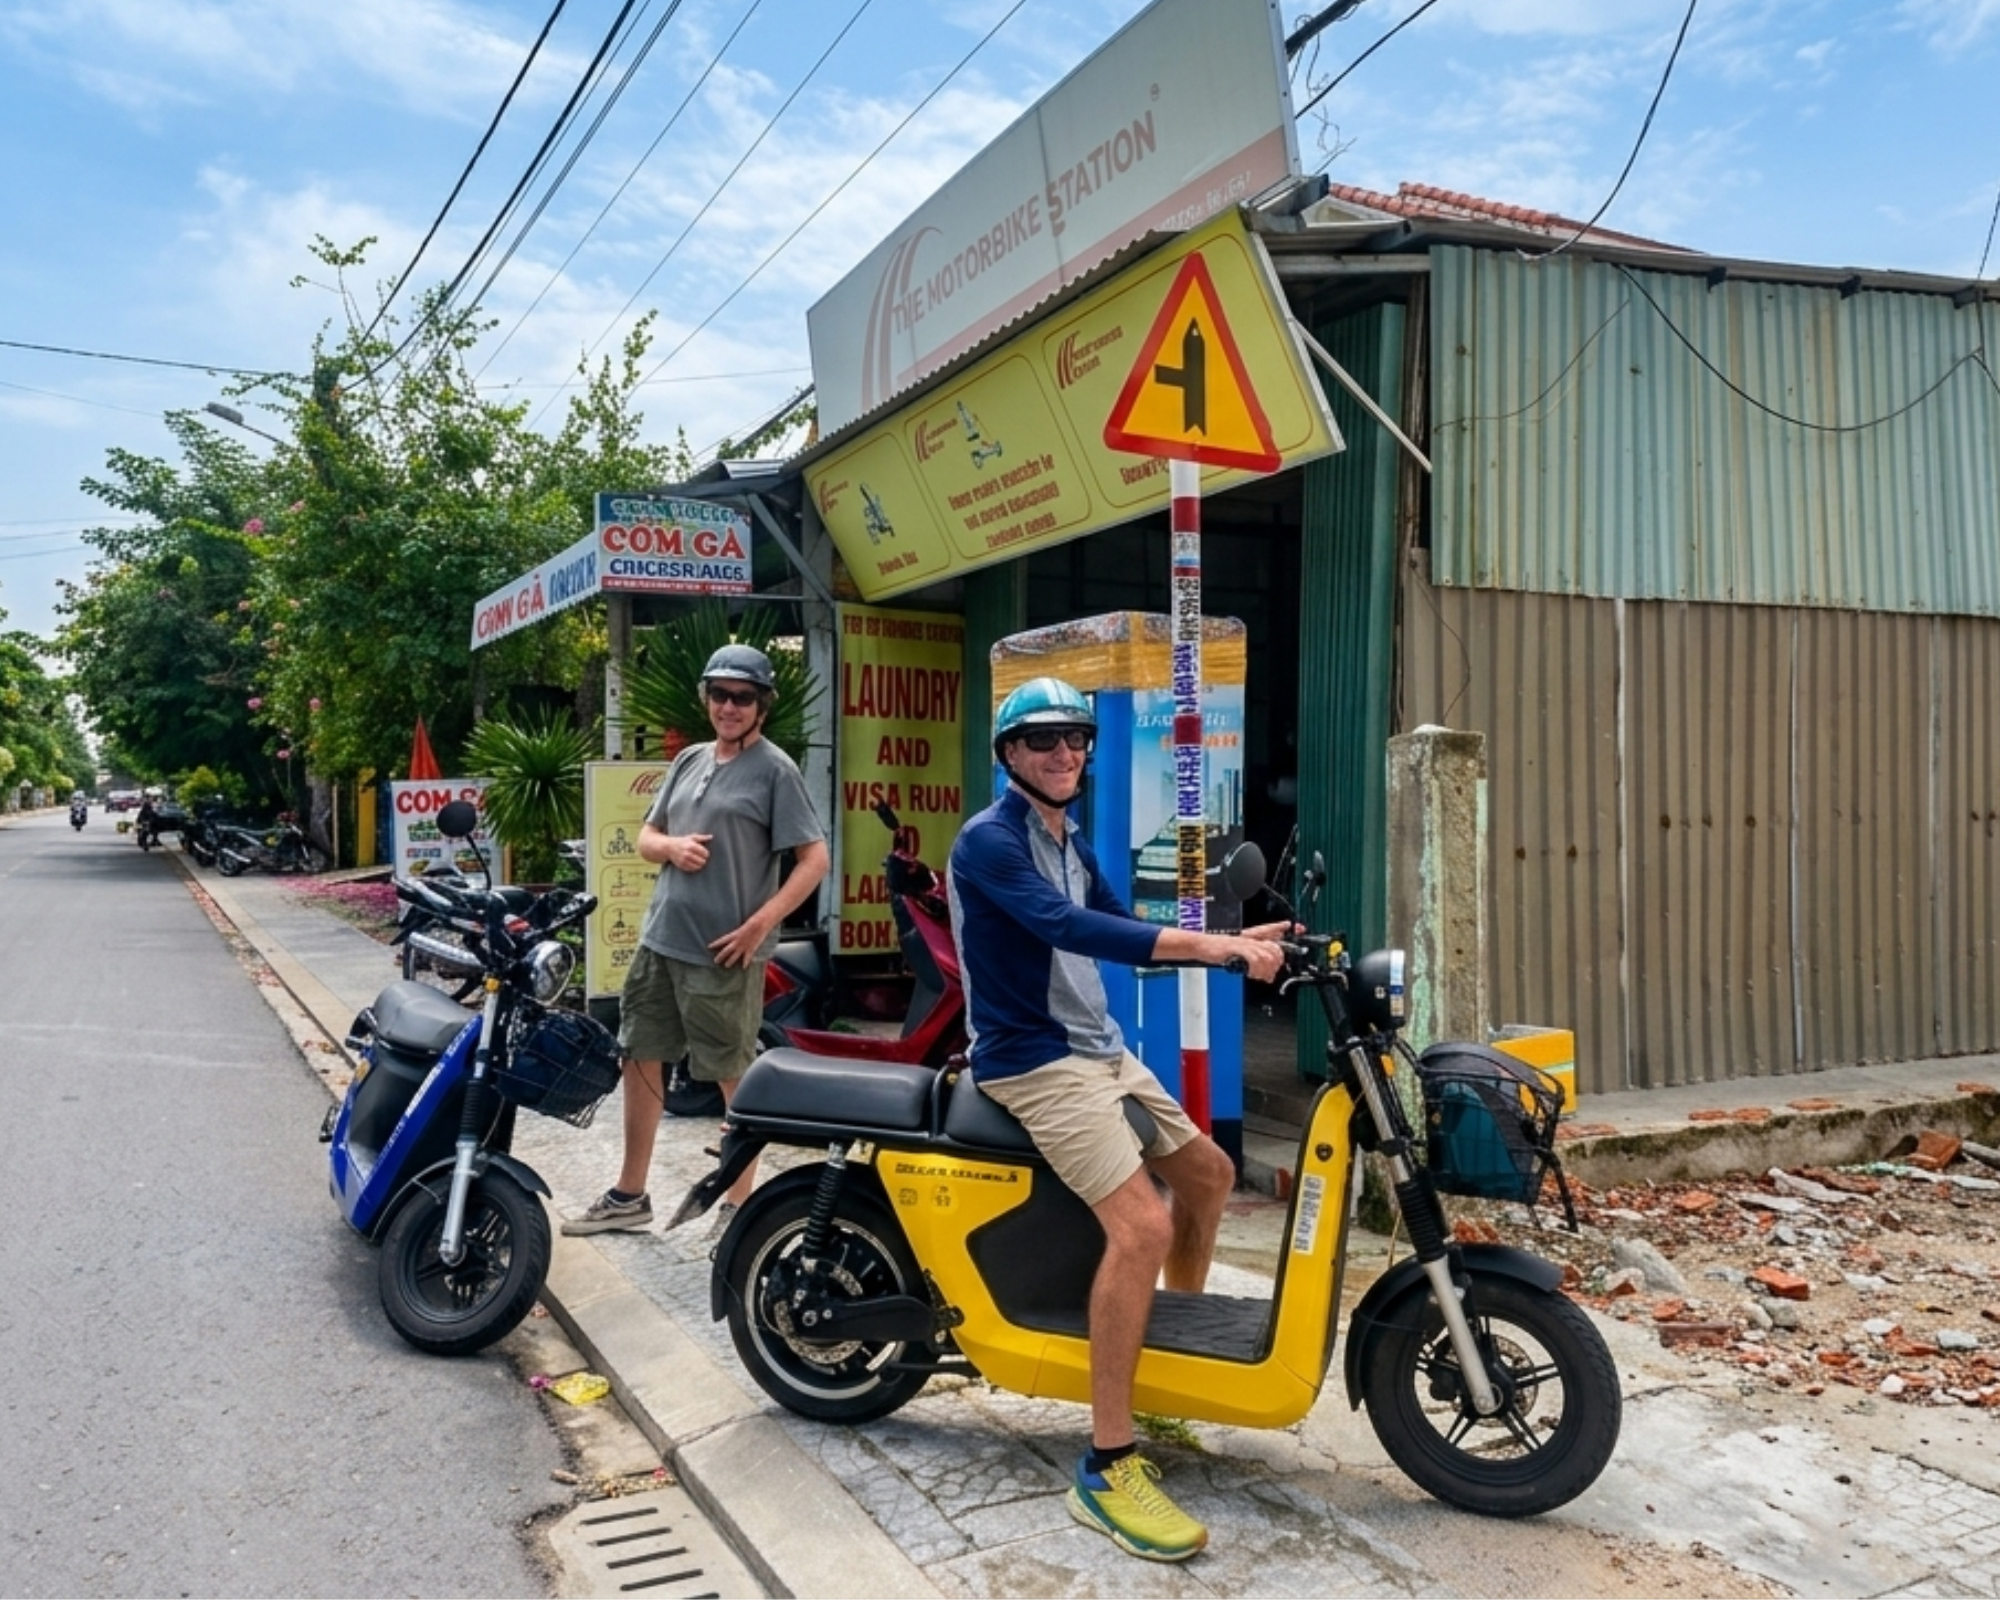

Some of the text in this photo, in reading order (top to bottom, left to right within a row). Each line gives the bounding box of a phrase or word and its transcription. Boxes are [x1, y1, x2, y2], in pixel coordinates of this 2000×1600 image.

[927, 194, 1042, 311] MOTORBIKE
[1046, 110, 1157, 238] STATION
[843, 662, 961, 722] LAUNDRY
[877, 735, 931, 767] AND
[843, 781, 960, 813] VISA RUN
